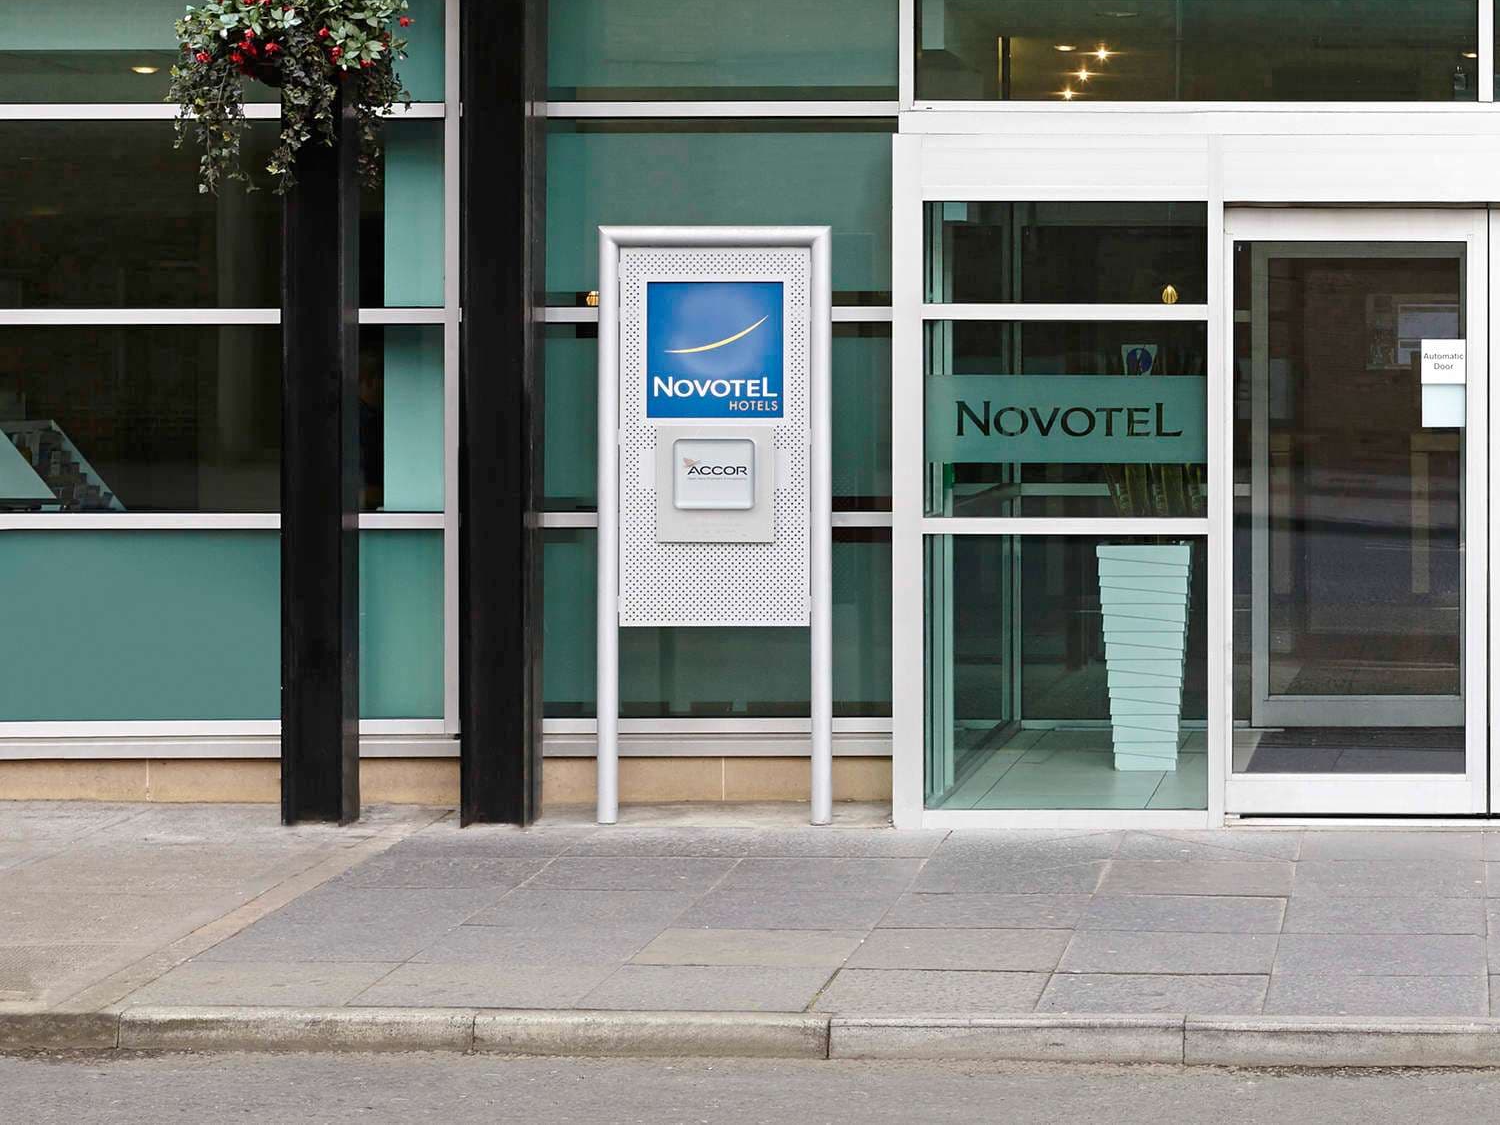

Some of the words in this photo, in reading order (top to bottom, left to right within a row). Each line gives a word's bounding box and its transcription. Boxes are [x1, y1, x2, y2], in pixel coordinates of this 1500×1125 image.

[653, 376, 778, 397] NOVOTEL
[729, 400, 778, 411] HOTELS
[956, 400, 1183, 437] NOVOTEL
[687, 466, 748, 476] ACCOR
